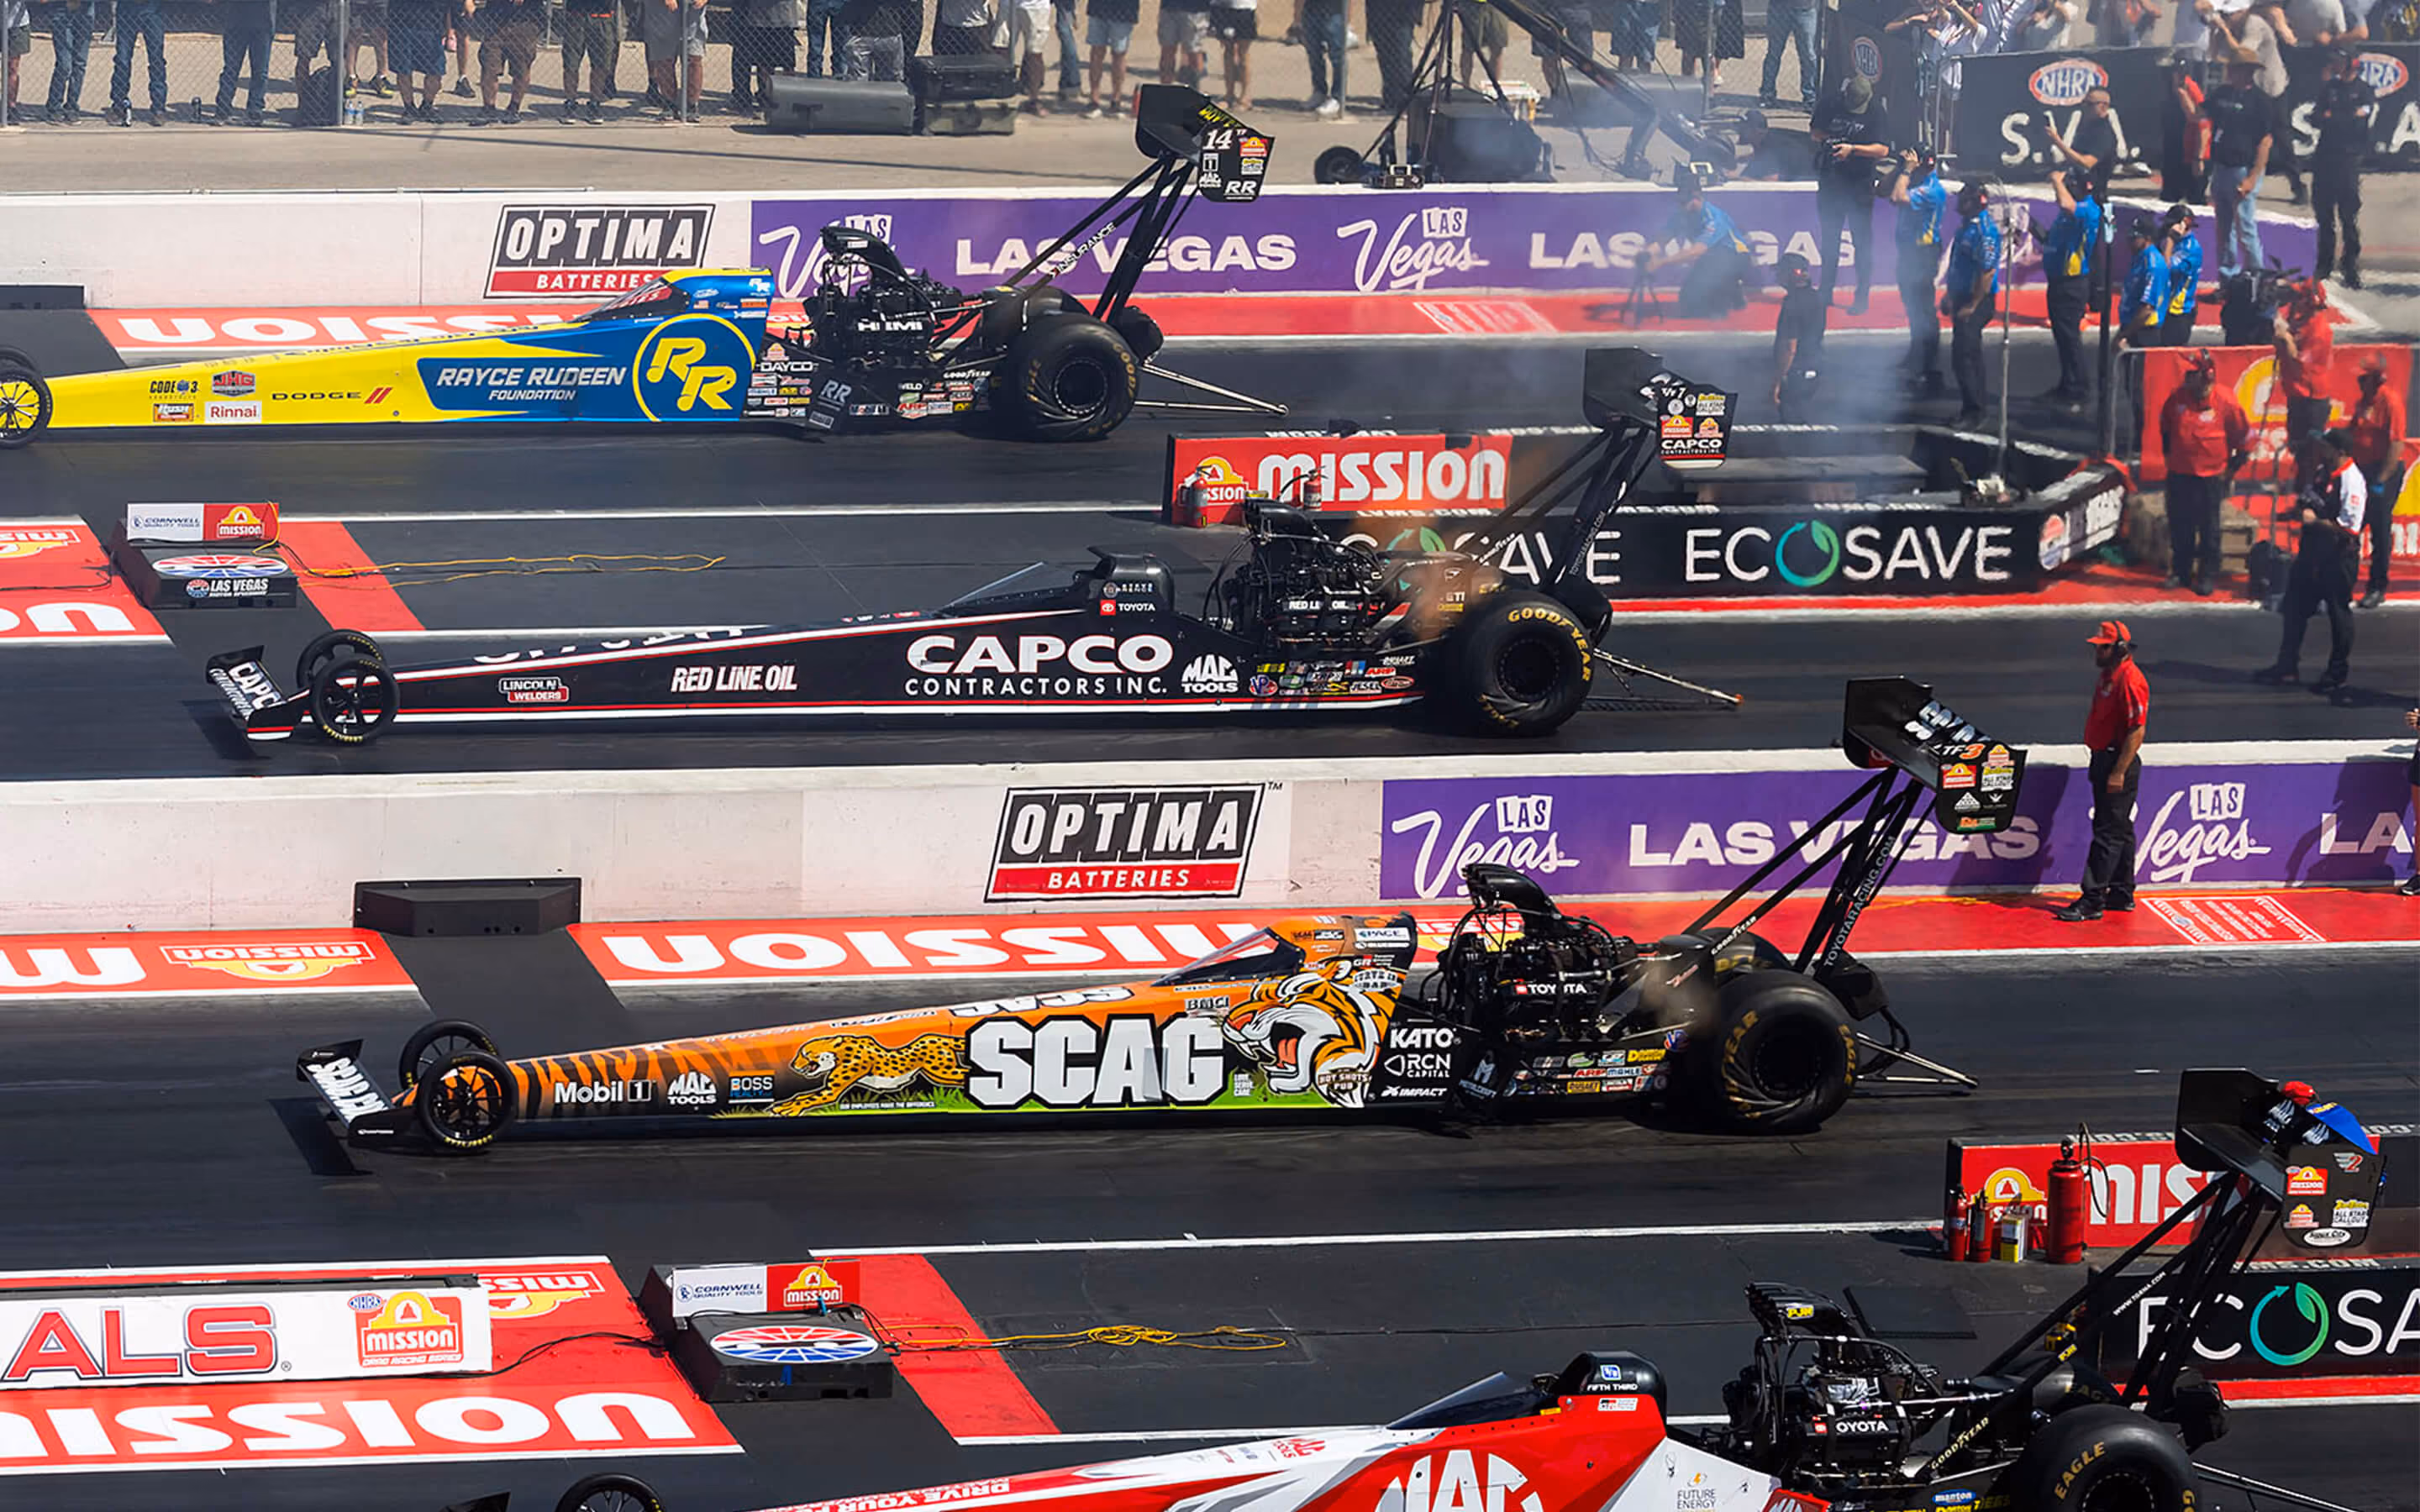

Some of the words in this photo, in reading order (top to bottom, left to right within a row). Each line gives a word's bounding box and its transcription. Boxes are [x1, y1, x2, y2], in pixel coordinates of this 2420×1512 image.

[1202, 129, 1234, 150] 14
[1224, 181, 1257, 195] RR
[1427, 210, 1465, 234] LAS
[505, 218, 694, 260] OPTIMA
[1055, 222, 1117, 276] INSURANCE
[956, 239, 1075, 276] LAS
[1338, 210, 1489, 291] Vegas
[1529, 231, 1645, 269] LAS
[537, 273, 654, 291] BATTERIES
[437, 367, 524, 386] RAYCE
[529, 366, 627, 386] RUDEEN
[760, 361, 814, 372] DAYCO
[150, 380, 177, 395] CODE
[191, 381, 198, 392] 3
[271, 390, 362, 401] DODGE
[489, 390, 576, 401] FOUNDATION
[210, 405, 257, 418] Rinnai
[1661, 438, 1723, 449] CAPCO
[1258, 449, 1507, 502] MISSION
[210, 579, 231, 591] LAS
[233, 578, 269, 591] VEGAS
[1117, 602, 1156, 612] TOYOTA
[906, 634, 1174, 675] CAPCO
[1181, 654, 1239, 683] MAC
[229, 661, 283, 708] CAPC
[502, 680, 556, 690] LINCOLN
[671, 666, 713, 693] RED
[715, 665, 763, 691] LINE
[764, 665, 798, 691] OIL
[904, 677, 1107, 696] CONTRACTORS
[1116, 677, 1168, 695] INC.
[1181, 682, 1239, 694] TOOLS
[513, 690, 562, 701] WELDERS
[2196, 786, 2240, 816] LAS
[1502, 798, 1548, 830] LAS
[1010, 799, 1239, 856] OPTIMA
[2318, 811, 2418, 855] LA
[1628, 821, 1776, 867] LAS
[1048, 869, 1190, 890] BATTERIES
[1711, 915, 1757, 956] GOODYEAR
[1390, 1027, 1455, 1049] KATO
[968, 1016, 1225, 1106] SCAG
[1407, 1053, 1451, 1069] RCN
[669, 1071, 717, 1096] MAC
[1407, 1068, 1450, 1079] CAPITAL
[555, 1081, 623, 1104] Mobil
[729, 1077, 774, 1092] BOSS
[667, 1095, 718, 1105] TOOLS
[693, 1290, 733, 1299] QUALITY
[734, 1289, 764, 1297] TOOLS
[694, 1283, 762, 1294] CORNWELL
[350, 1295, 381, 1310] NHRA
[366, 1328, 455, 1352] MISSION
[1586, 1383, 1611, 1392] FIFTH
[1612, 1383, 1639, 1392] THIRD
[1932, 1416, 1990, 1471] GOODYEAR
[2054, 1441, 2107, 1501] EAGLE
[930, 1483, 1010, 1503] DRIVE
[1676, 1488, 1716, 1499] FUTURE
[1934, 1492, 1973, 1503] manton
[1676, 1499, 1717, 1510] ENERGY
